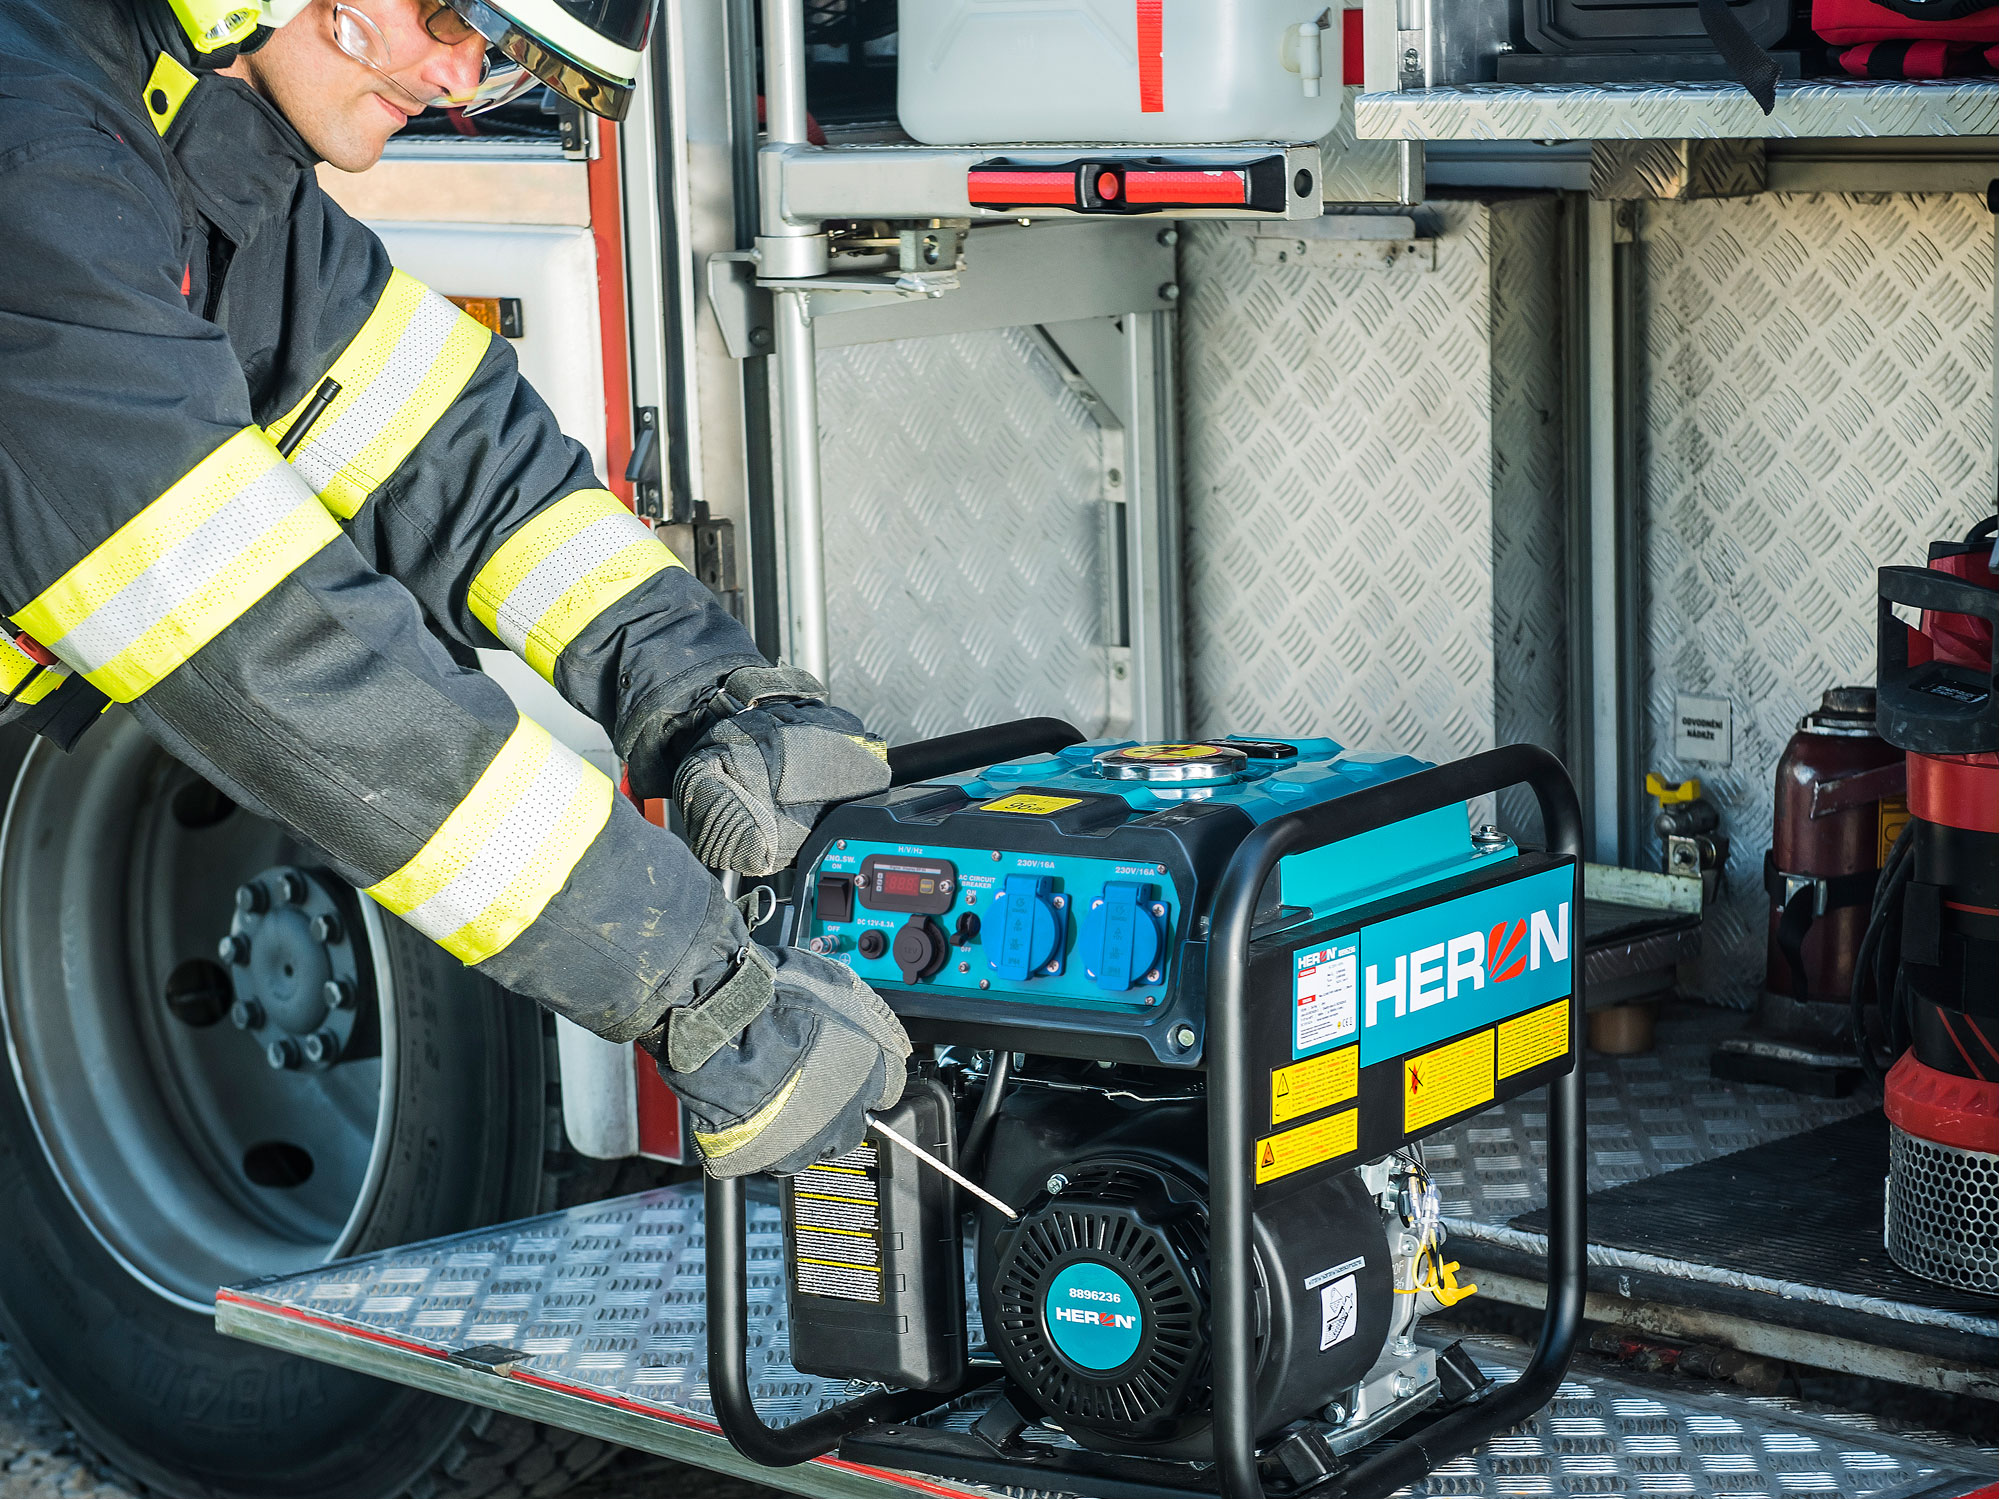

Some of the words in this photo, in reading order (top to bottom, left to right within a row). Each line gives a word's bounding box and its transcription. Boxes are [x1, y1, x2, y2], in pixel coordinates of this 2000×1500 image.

[898, 846, 923, 854] H/V/Hz
[1017, 859, 1055, 869] 230V/16A
[1115, 866, 1155, 876] 230V/16A
[969, 875, 996, 883] CIRCUIT
[1298, 947, 1336, 969] HERON
[1366, 902, 1568, 1028] HERON
[1069, 1287, 1121, 1303] 8896236
[1056, 1307, 1133, 1330] HERON
